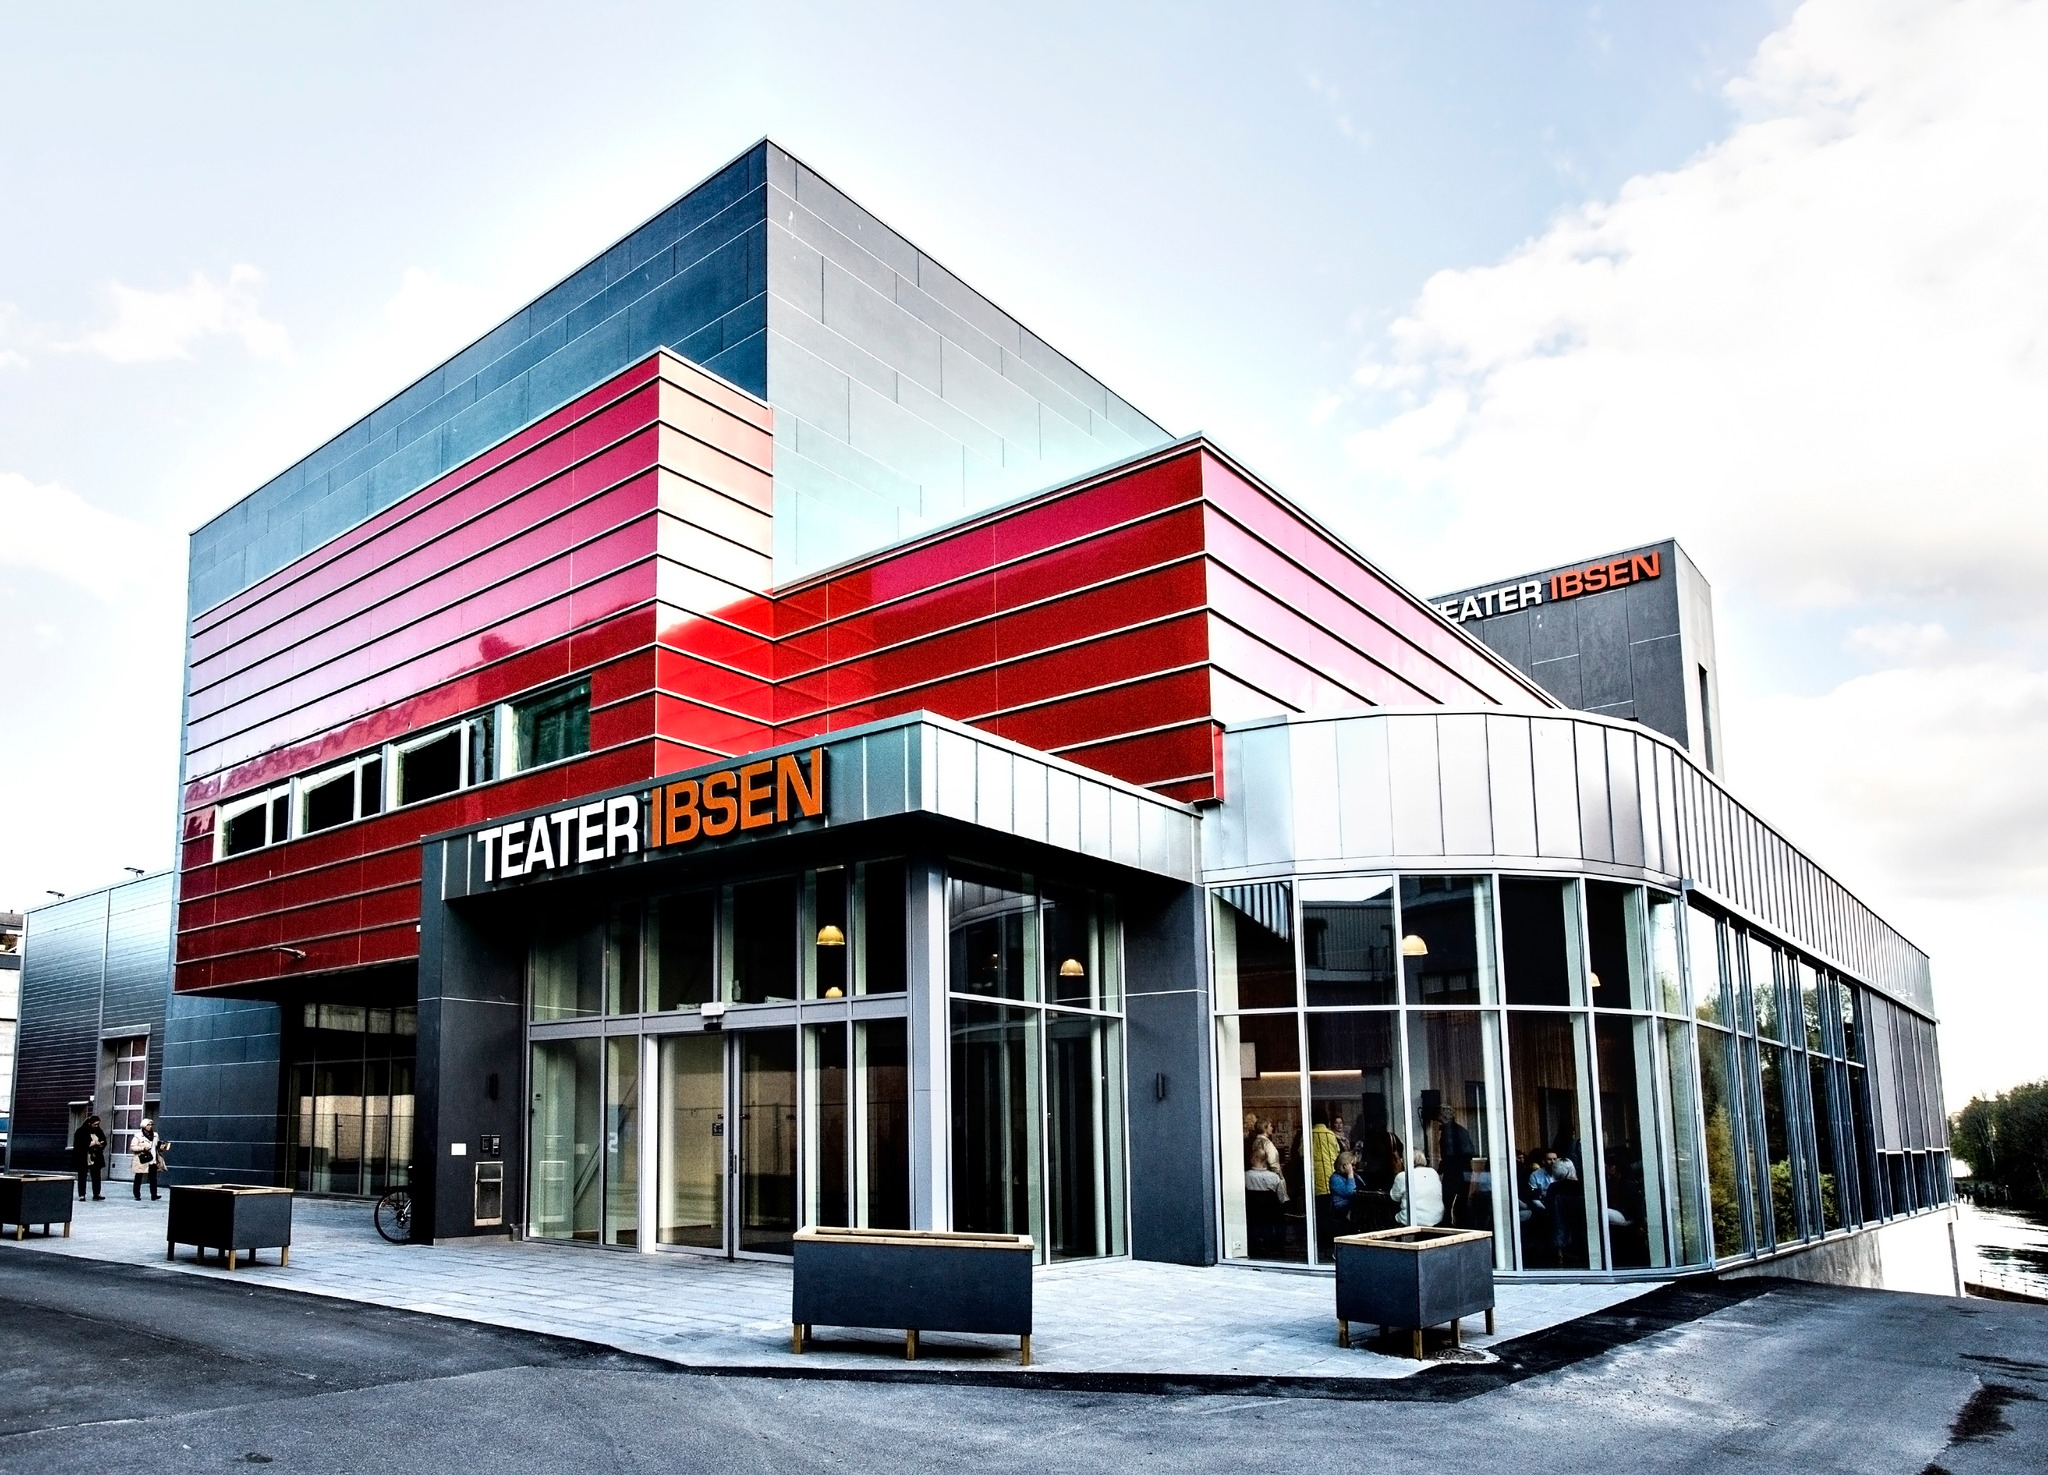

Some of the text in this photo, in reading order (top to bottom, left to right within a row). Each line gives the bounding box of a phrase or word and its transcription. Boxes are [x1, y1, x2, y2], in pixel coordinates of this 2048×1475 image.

[1432, 552, 1660, 623] EATER IBSEN
[477, 747, 825, 882] TEATER IBSEN
